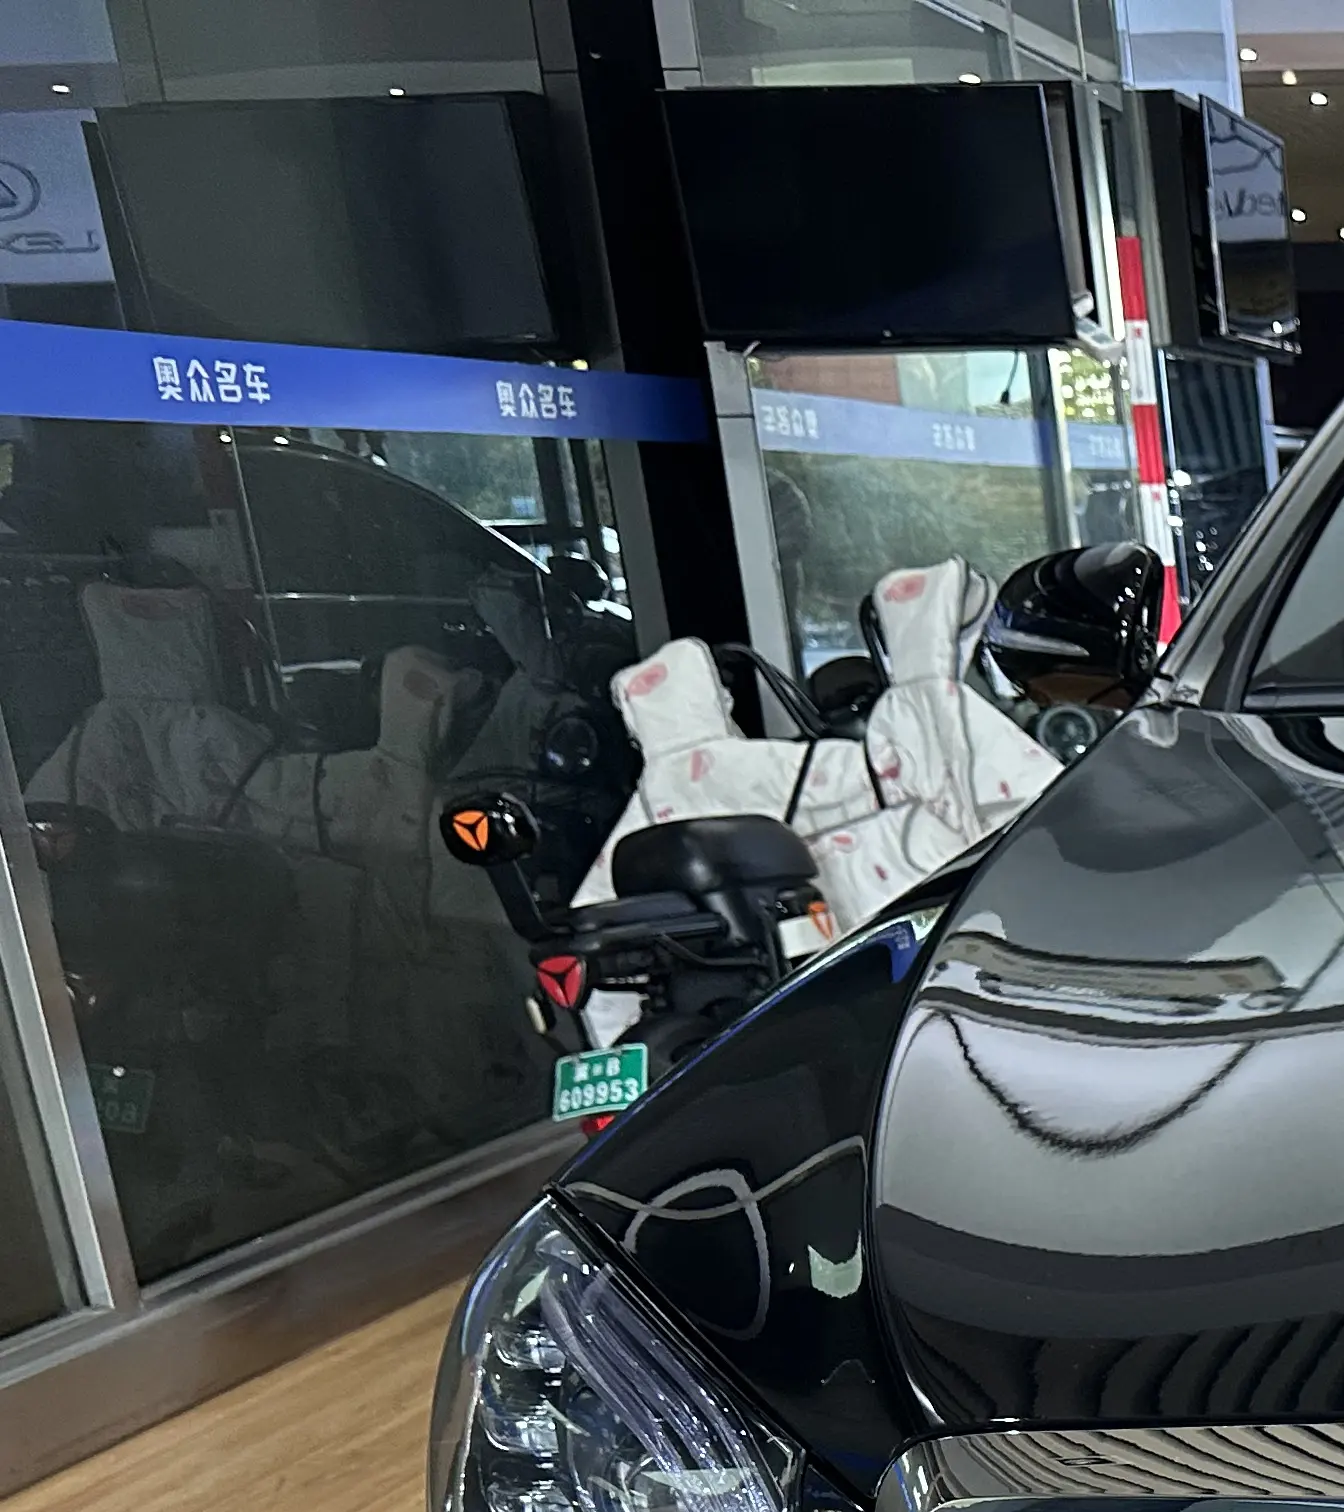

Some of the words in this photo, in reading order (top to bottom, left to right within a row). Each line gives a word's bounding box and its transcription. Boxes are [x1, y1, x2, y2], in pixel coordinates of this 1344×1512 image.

[152, 355, 272, 405] 奥众名车
[494, 379, 578, 420] 奥众名车
[560, 1077, 640, 1112] 609953
